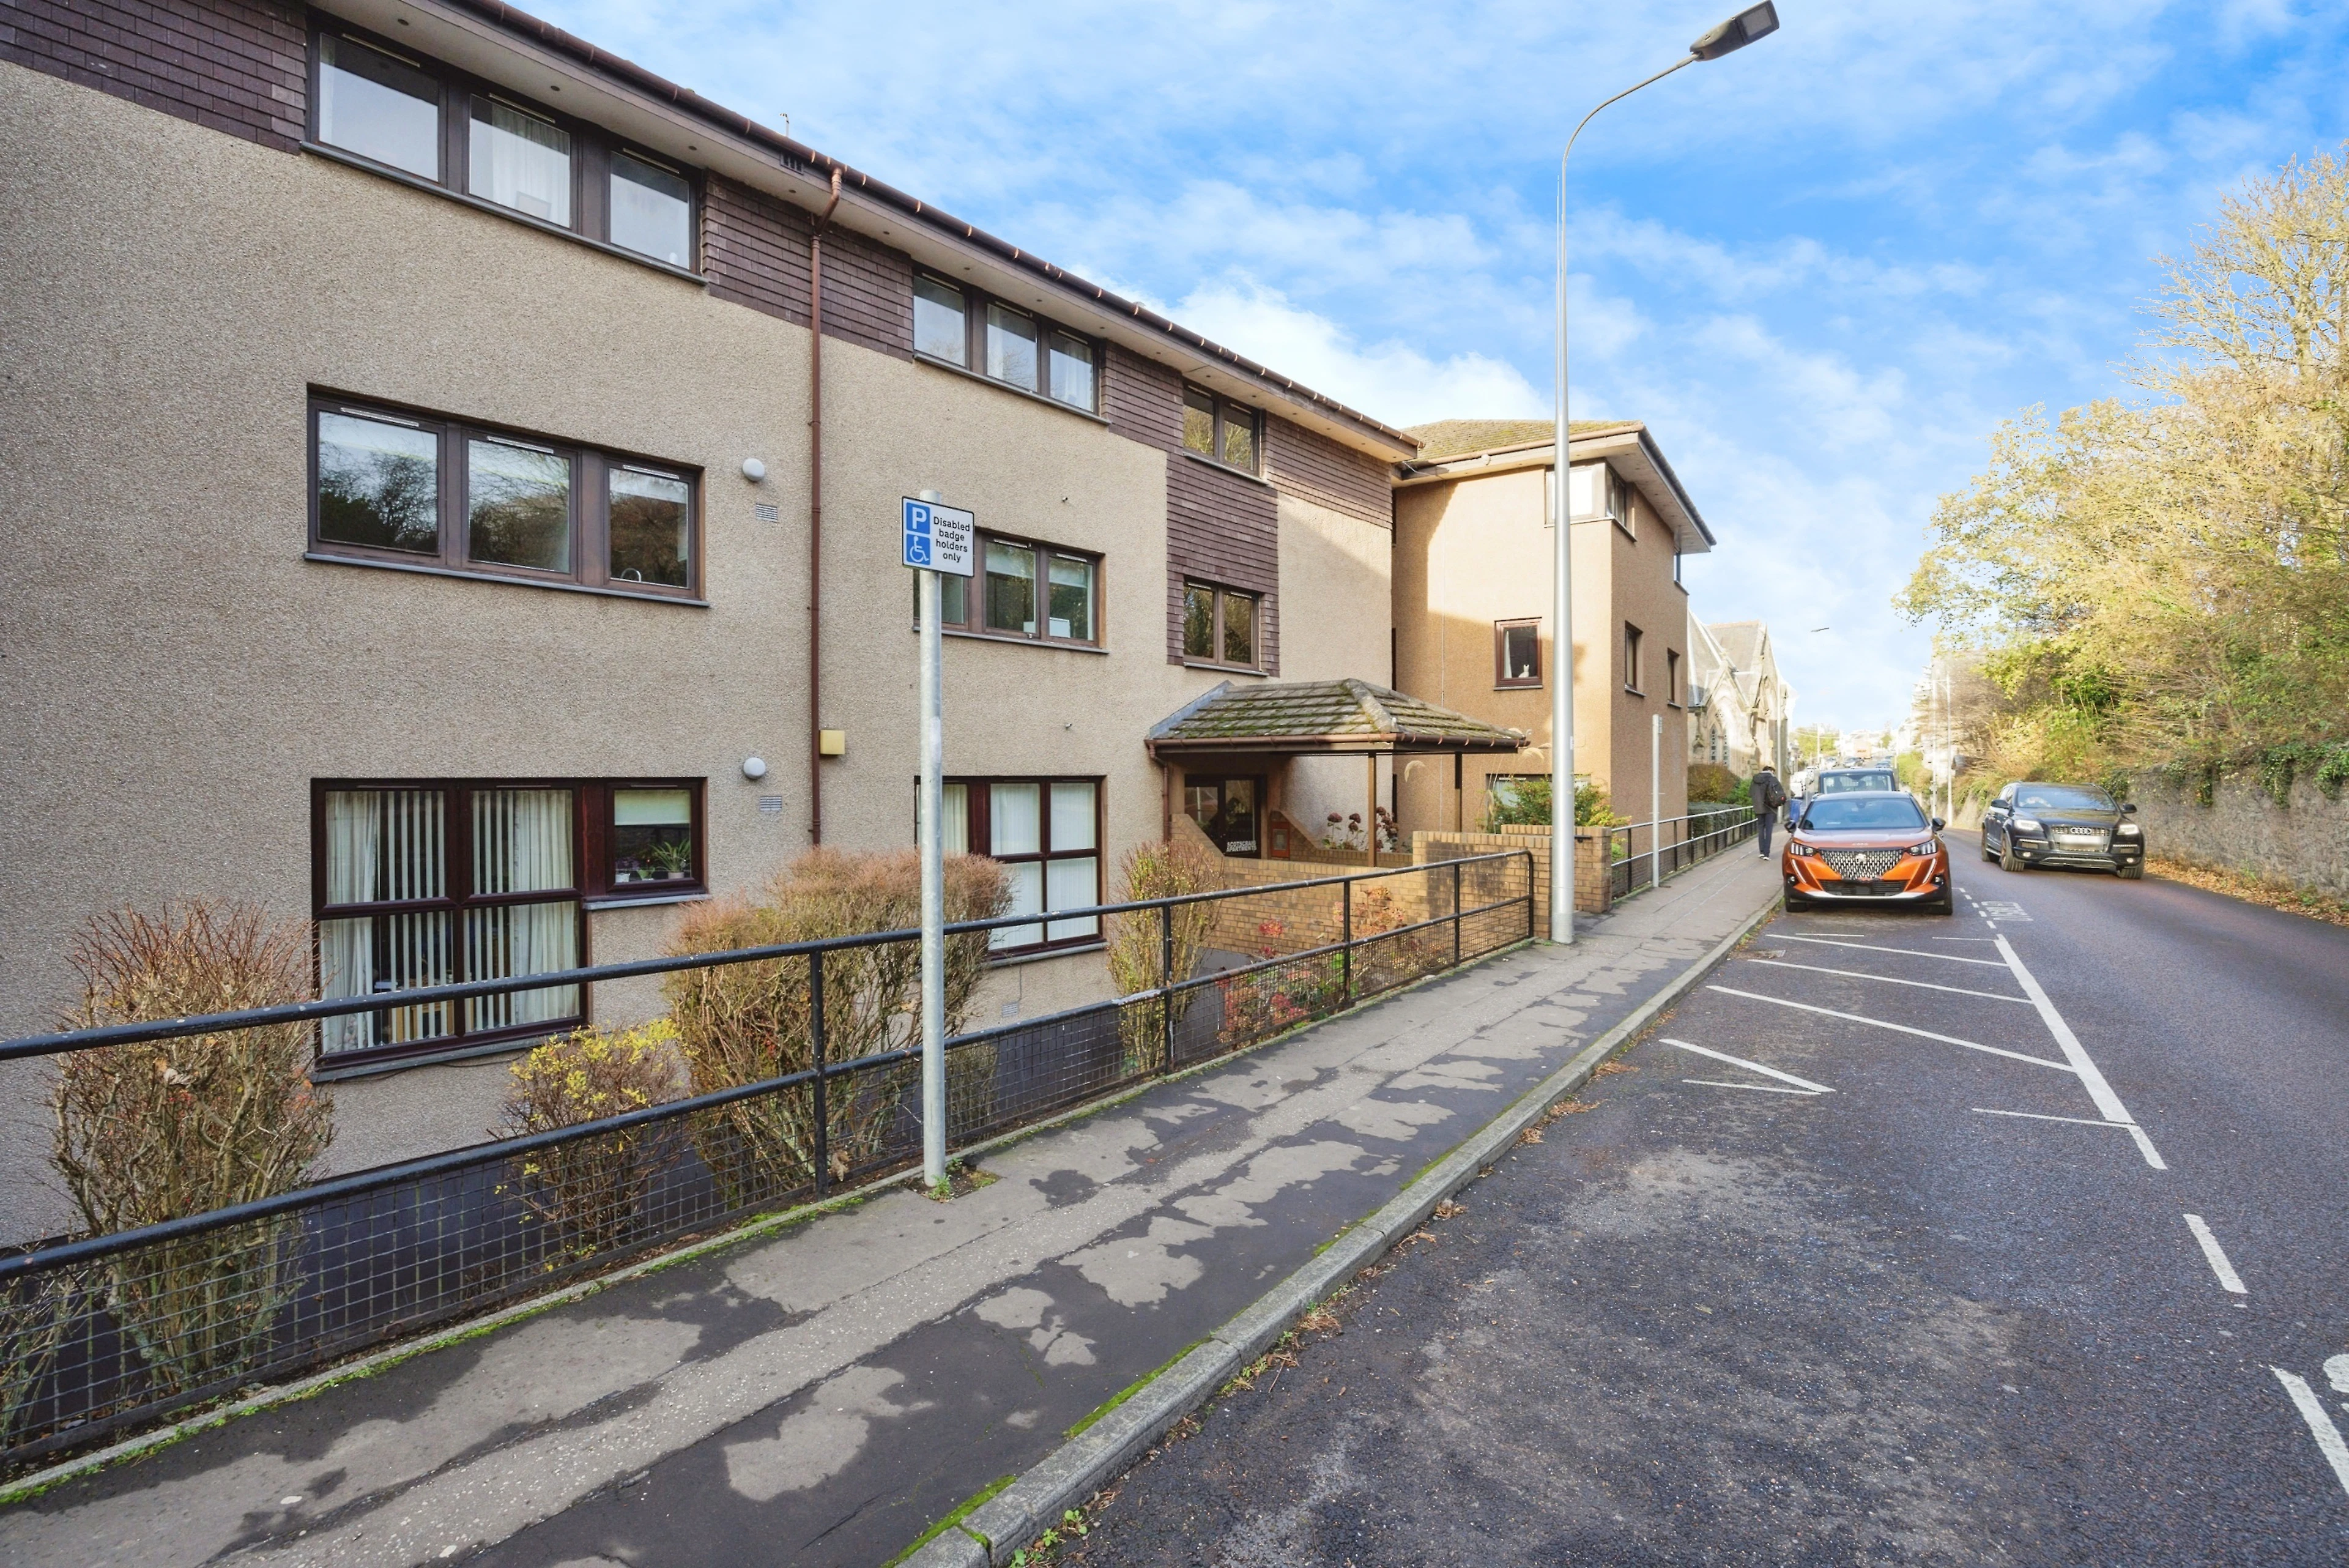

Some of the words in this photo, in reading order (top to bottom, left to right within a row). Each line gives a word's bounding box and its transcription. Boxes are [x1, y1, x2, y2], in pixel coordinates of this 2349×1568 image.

[912, 507, 927, 530] P
[933, 516, 970, 532] Disabled
[939, 529, 965, 541] badge
[936, 539, 968, 552] holders
[943, 552, 961, 563] only
